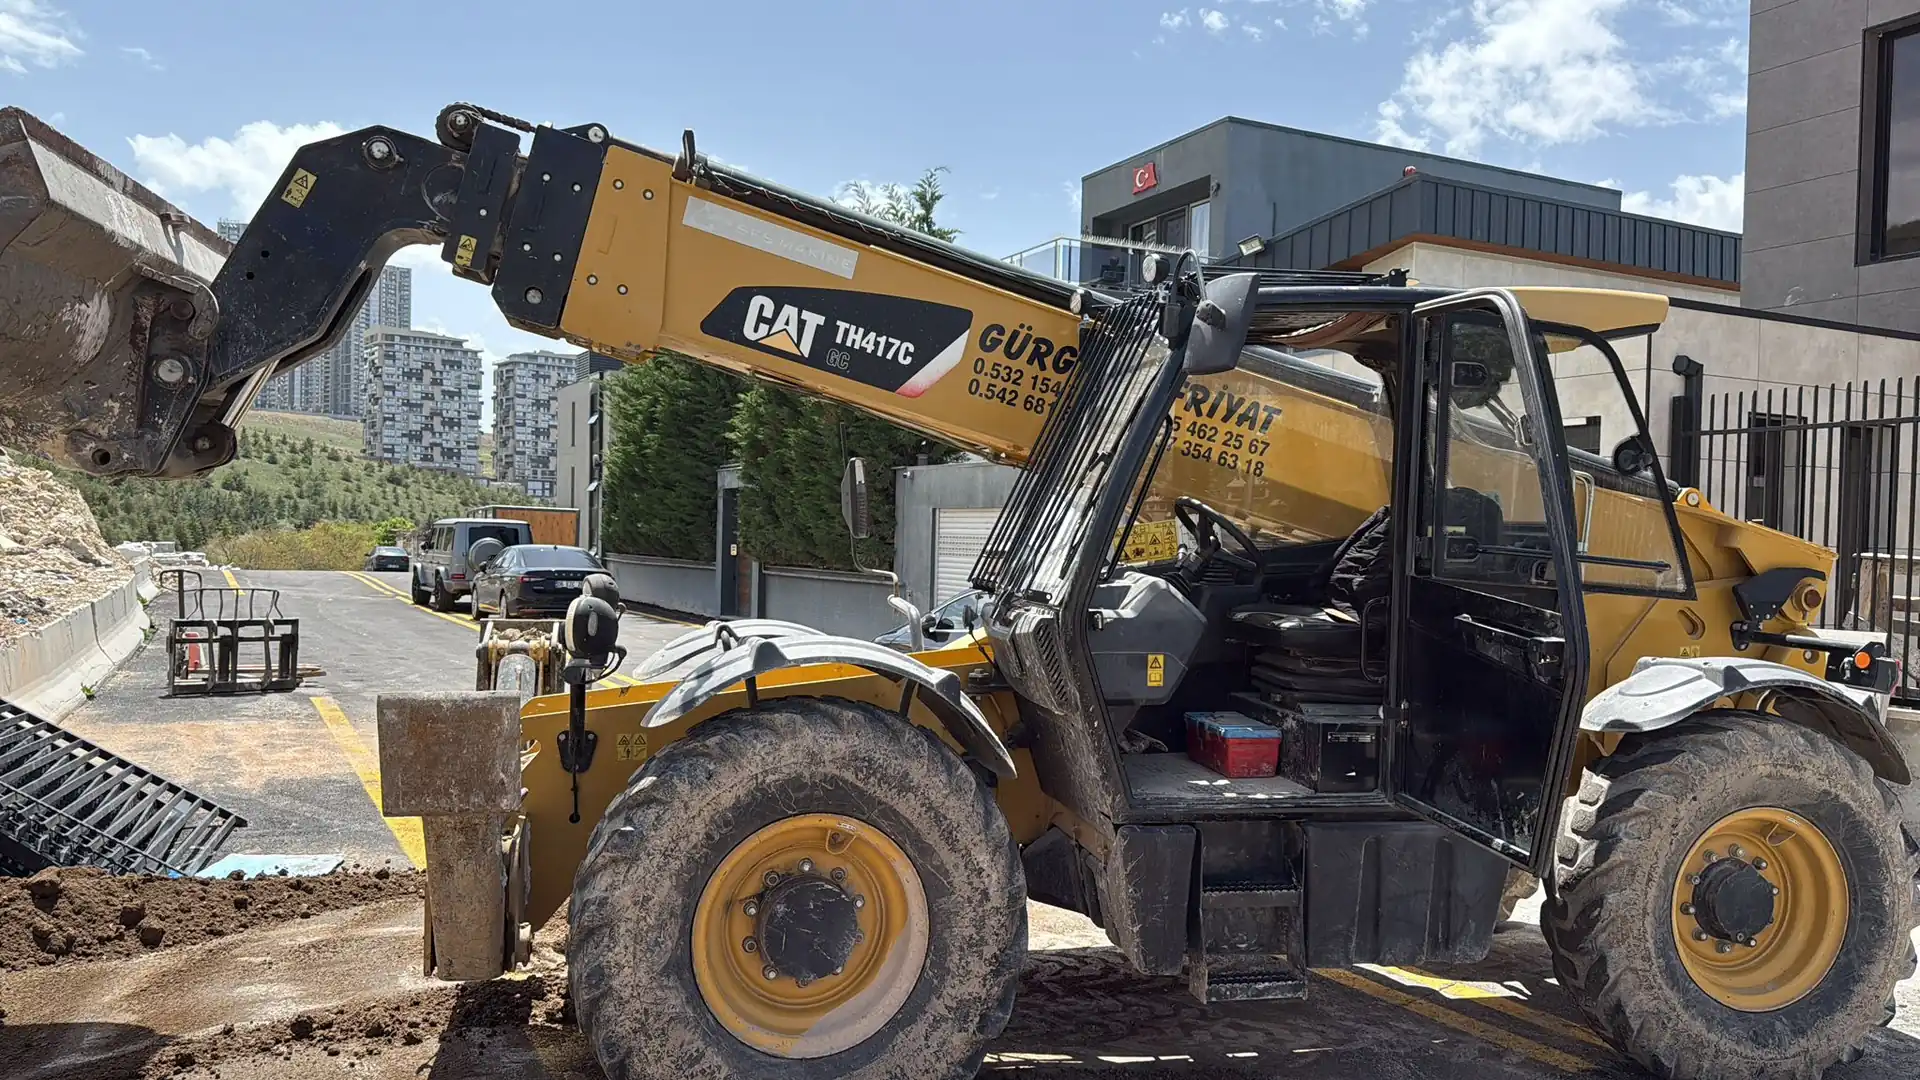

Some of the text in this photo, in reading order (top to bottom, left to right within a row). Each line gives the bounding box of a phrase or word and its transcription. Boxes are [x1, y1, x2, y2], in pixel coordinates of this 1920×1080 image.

[742, 294, 826, 359] CAT
[834, 319, 915, 366] TH417C
[978, 322, 1078, 375] GÜRG
[826, 347, 851, 370] GC
[968, 378, 1019, 407] 0.542
[1180, 440, 1213, 463] 354
[1217, 449, 1239, 470] 63
[1245, 458, 1265, 478] 18
[973, 357, 1024, 386] 0.532
[1031, 374, 1063, 397] 154
[1186, 420, 1219, 443] 462
[1221, 430, 1244, 451] 25
[1248, 438, 1271, 457] 67
